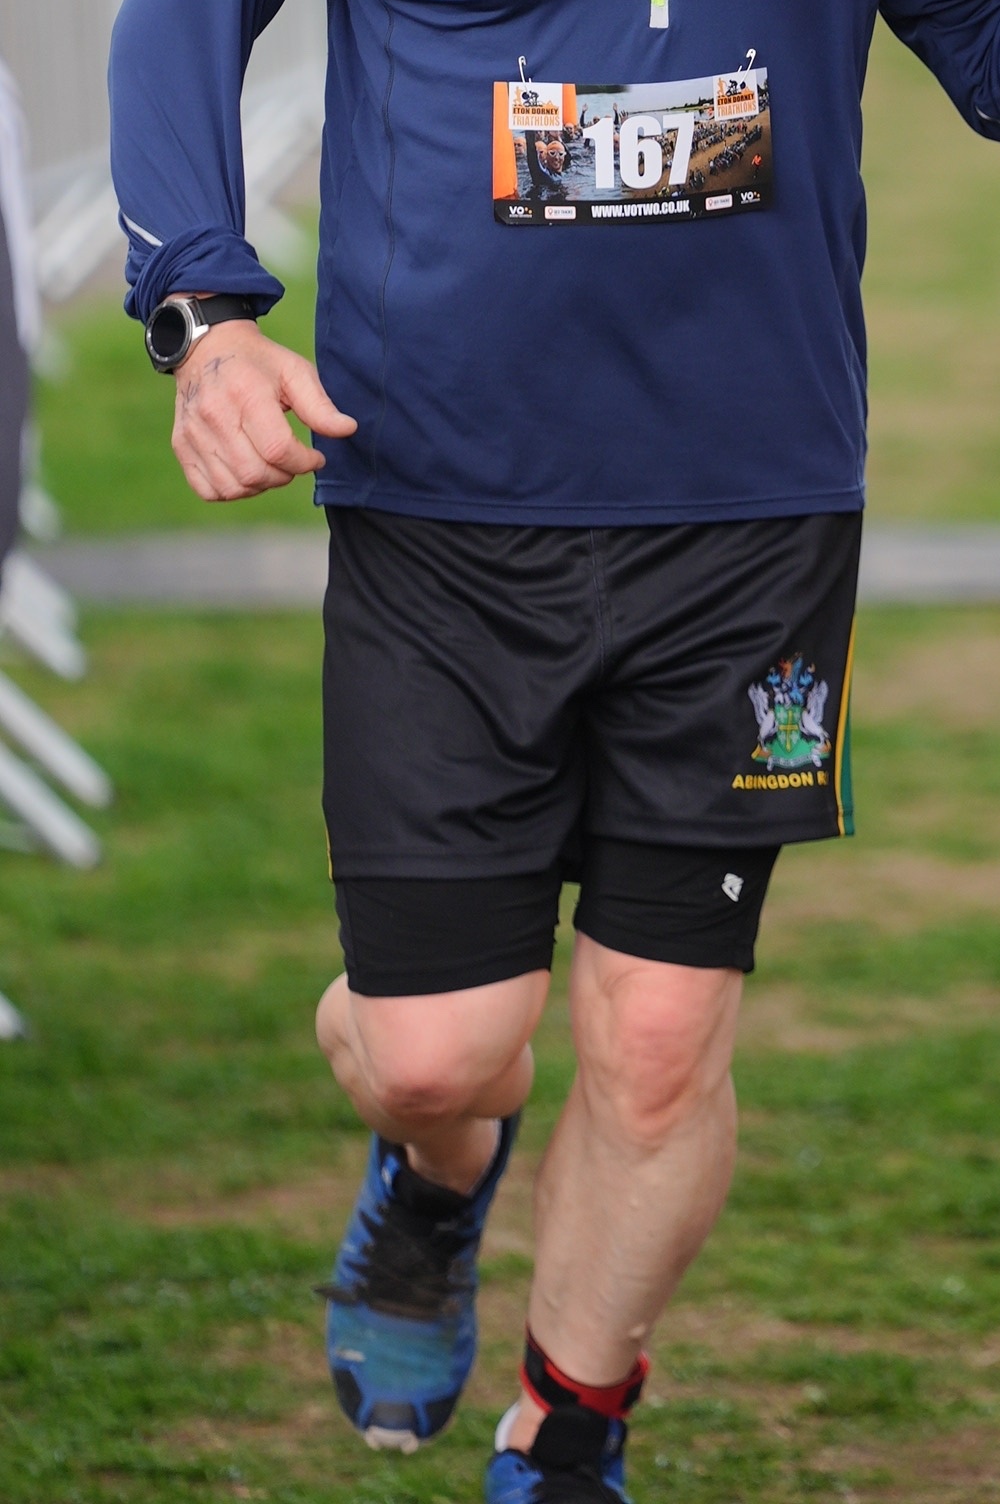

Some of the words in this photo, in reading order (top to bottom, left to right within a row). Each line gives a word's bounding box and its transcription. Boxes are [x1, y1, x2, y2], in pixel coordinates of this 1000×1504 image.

[717, 97, 732, 106] ETON
[732, 94, 755, 103] DORNEY
[513, 107, 530, 115] ETON
[531, 107, 559, 115] DORNEY
[512, 115, 560, 126] TRIATHLONS
[583, 111, 695, 190] 167
[591, 199, 690, 219] WWW.VOTWO.CO.UK
[732, 771, 814, 790] ABINGDON
